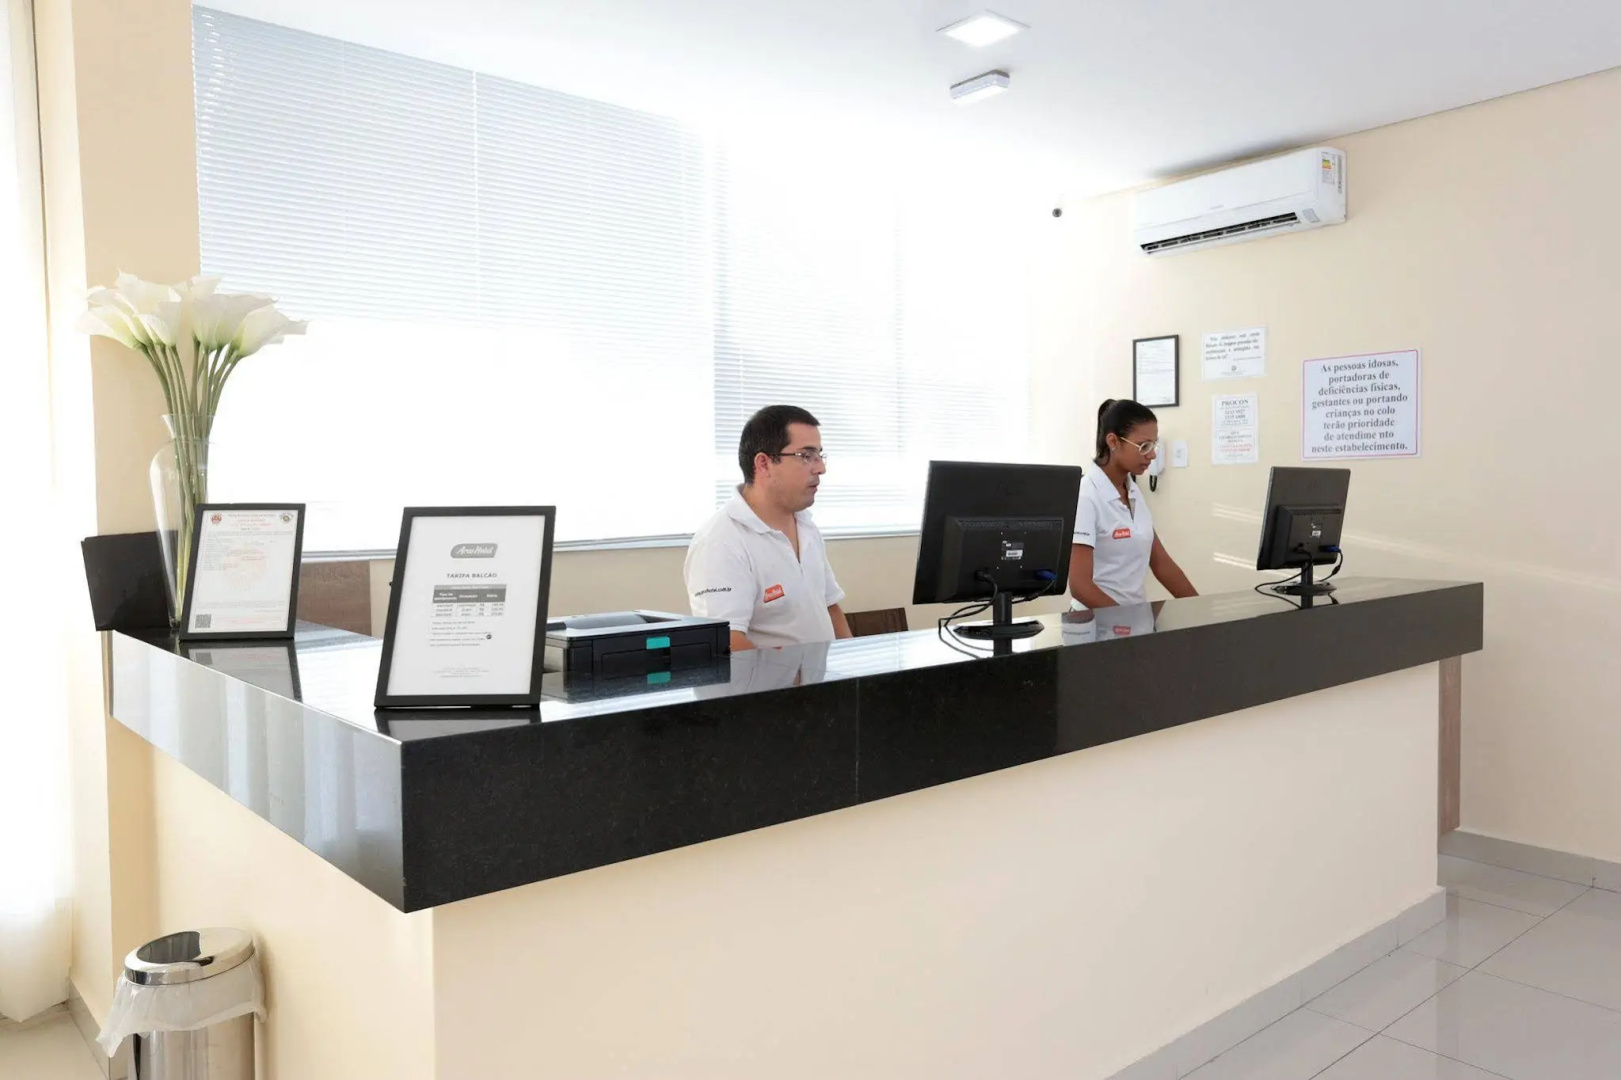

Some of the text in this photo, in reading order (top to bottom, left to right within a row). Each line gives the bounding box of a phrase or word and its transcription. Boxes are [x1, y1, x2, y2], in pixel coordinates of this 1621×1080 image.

[1321, 359, 1399, 374] As pessoas idosas,
[1328, 371, 1390, 385] portadoras de
[1318, 384, 1368, 396] deficiências
[1312, 398, 1350, 410] gestantes
[1366, 394, 1408, 406] portando
[1326, 409, 1361, 418] crianças
[1377, 406, 1396, 414] colo
[1324, 418, 1395, 430] terão prioridade
[1324, 432, 1334, 441] de
[1312, 442, 1408, 453] neste estabelecimento.
